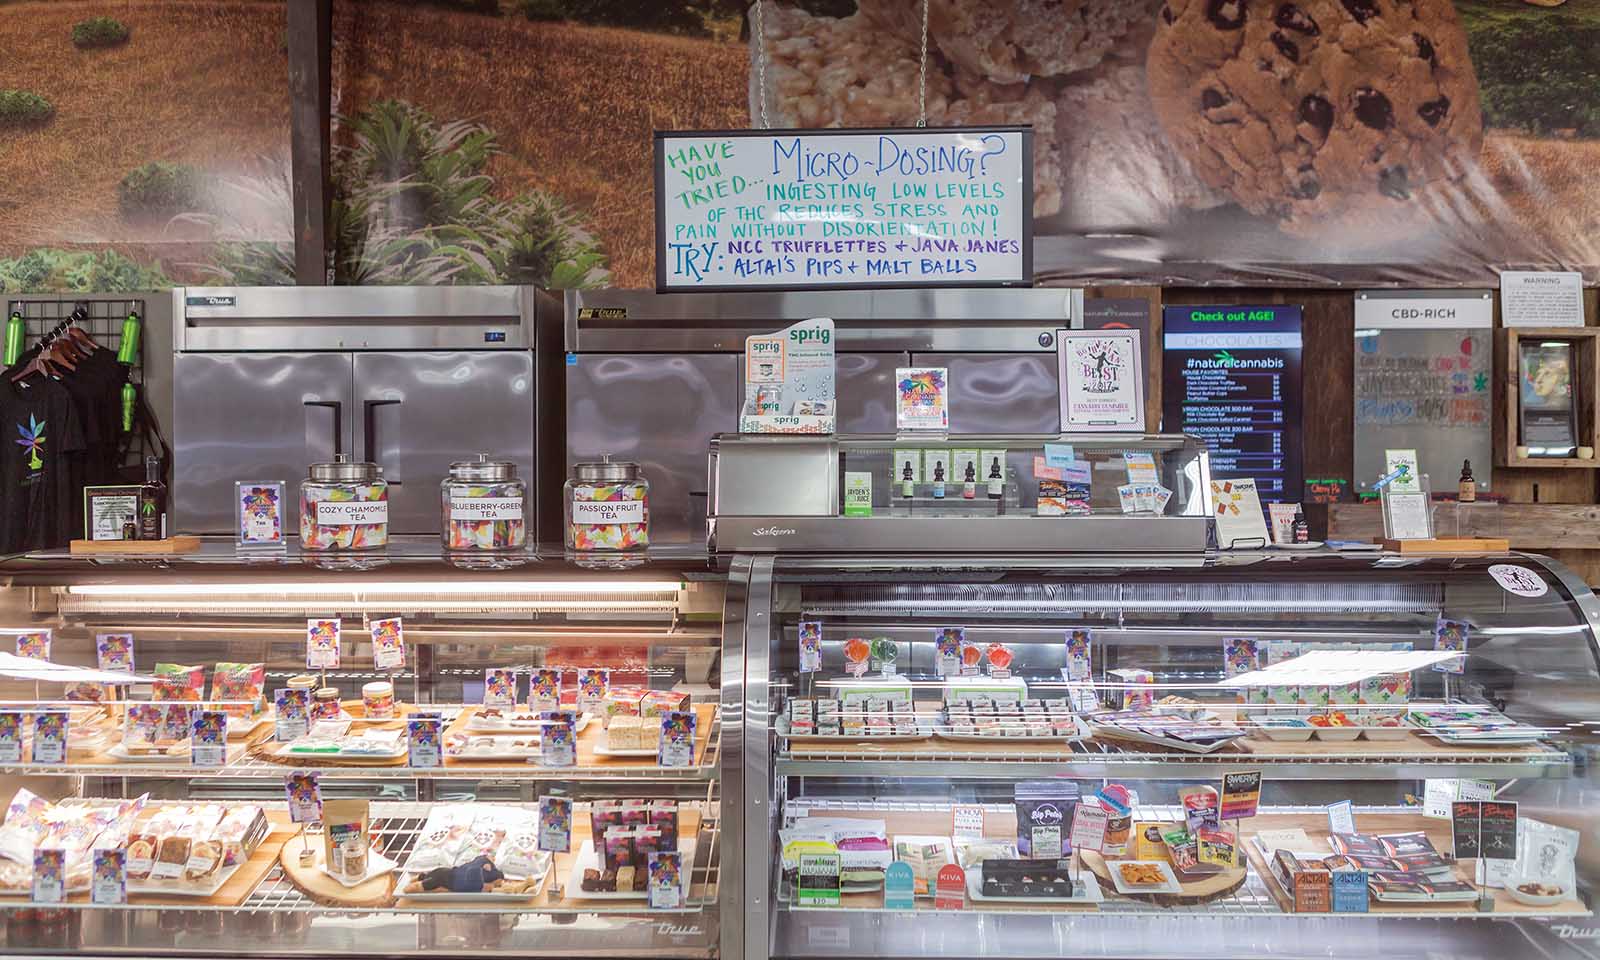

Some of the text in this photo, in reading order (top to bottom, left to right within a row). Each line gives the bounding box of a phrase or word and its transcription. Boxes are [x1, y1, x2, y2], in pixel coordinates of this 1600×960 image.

[667, 141, 735, 168] HAVE
[681, 162, 721, 185] YOU
[767, 182, 1005, 202] INGESTING LOW LEVELS
[708, 203, 999, 223] OF THC REDUCES STRESS AND
[675, 224, 718, 240] PAIN
[731, 223, 806, 239] WITHOUT
[728, 241, 763, 254] NCC
[771, 240, 887, 254] TRUFFLETTES
[912, 237, 958, 253] JAVA
[963, 240, 1019, 253] JANES
[669, 242, 725, 282] TRY:
[734, 255, 796, 278] ALTAI'S
[807, 258, 843, 277] PIPS
[867, 259, 912, 276] MALT
[920, 258, 977, 274] BALLS
[1191, 312, 1223, 322] Check
[1227, 313, 1246, 322] out
[1392, 308, 1456, 319] CBD-RICH
[790, 326, 830, 344] sprig
[1184, 335, 1283, 347] CHOCOLATES
[752, 341, 780, 353] sprig
[1187, 357, 1283, 368] #naturalcannabis
[774, 416, 799, 426] sprig
[319, 505, 387, 514] COZY CHAMOMILE
[579, 504, 637, 513] PASSION FRUIT
[350, 514, 367, 522] TEA
[480, 511, 498, 519] TEA
[601, 512, 618, 520] TEA
